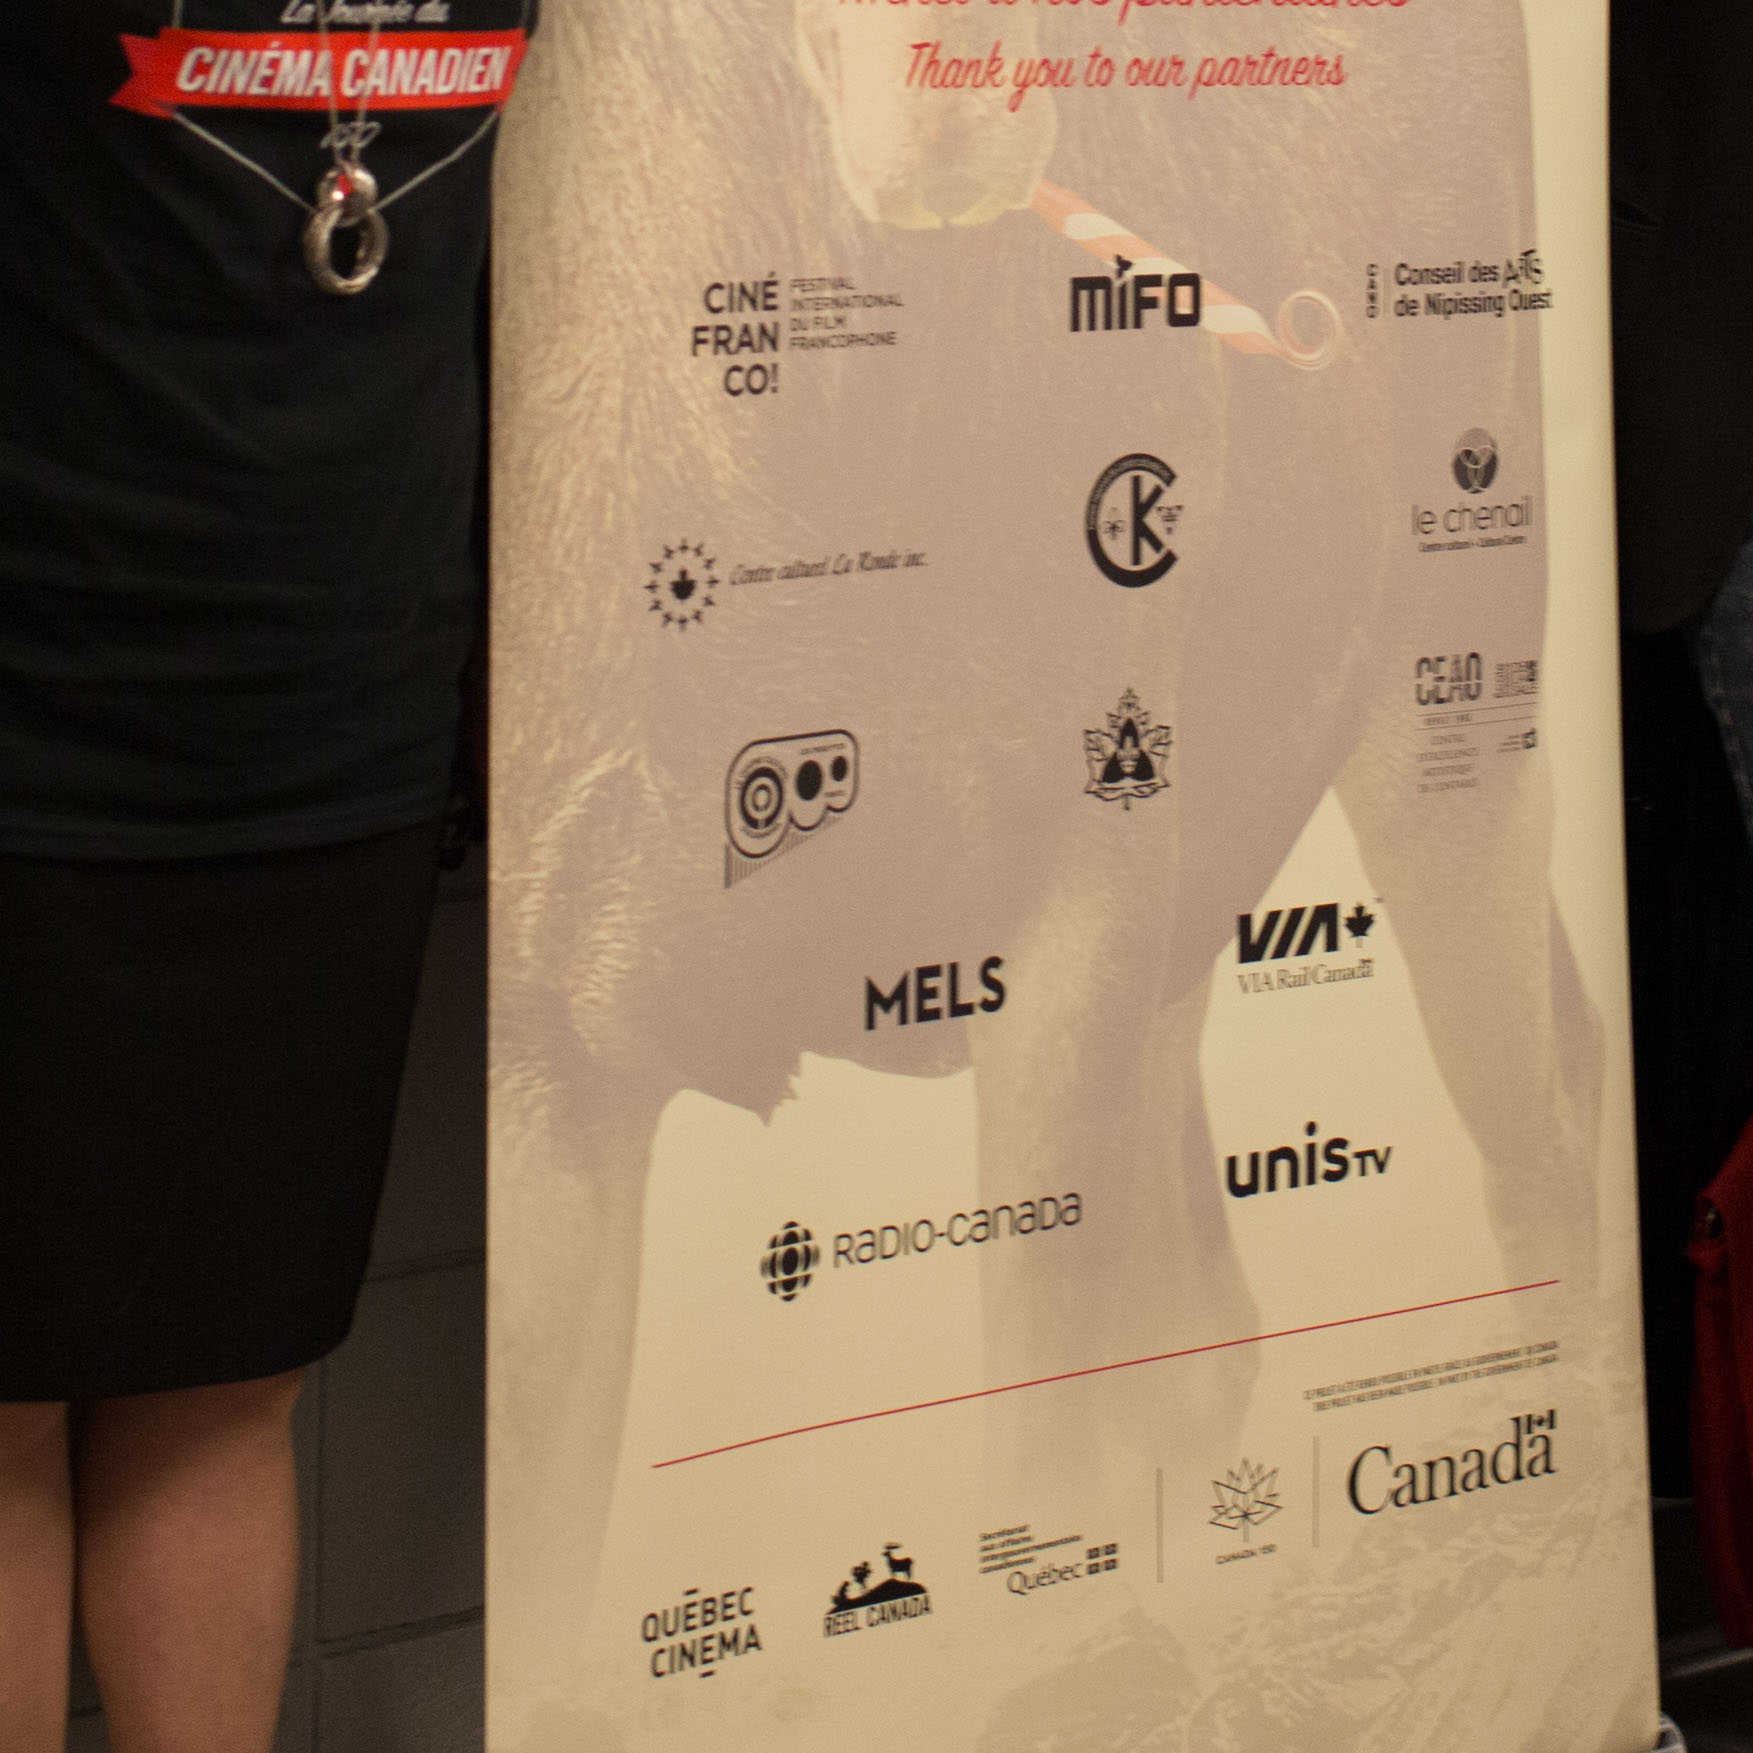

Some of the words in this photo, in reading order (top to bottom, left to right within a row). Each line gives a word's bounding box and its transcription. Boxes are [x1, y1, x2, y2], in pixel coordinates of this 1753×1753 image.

[176, 42, 332, 98] CINÉMA
[341, 46, 512, 97] CANADIEN
[905, 40, 1007, 89] Thank
[1012, 53, 1076, 113] you
[1083, 45, 1115, 87] to
[1123, 53, 1186, 88] our
[1188, 45, 1346, 100] partners
[703, 271, 779, 314] CINÉ
[1396, 261, 1466, 286] Conseil
[1469, 260, 1500, 284] des
[1395, 294, 1419, 317] de
[691, 321, 779, 357] FRAN
[723, 363, 779, 396] CO!
[1412, 505, 1436, 535] le
[1443, 496, 1533, 533] chenail
[1238, 903, 1339, 964] VIA
[865, 956, 1008, 1030] MELS
[1238, 971, 1275, 994] VIA
[1277, 965, 1311, 990] Rail
[1348, 1409, 1557, 1515] Canada
[1007, 1562, 1083, 1595] Québec
[824, 1611, 861, 1638] REEL
[866, 1594, 932, 1627] CANADA
